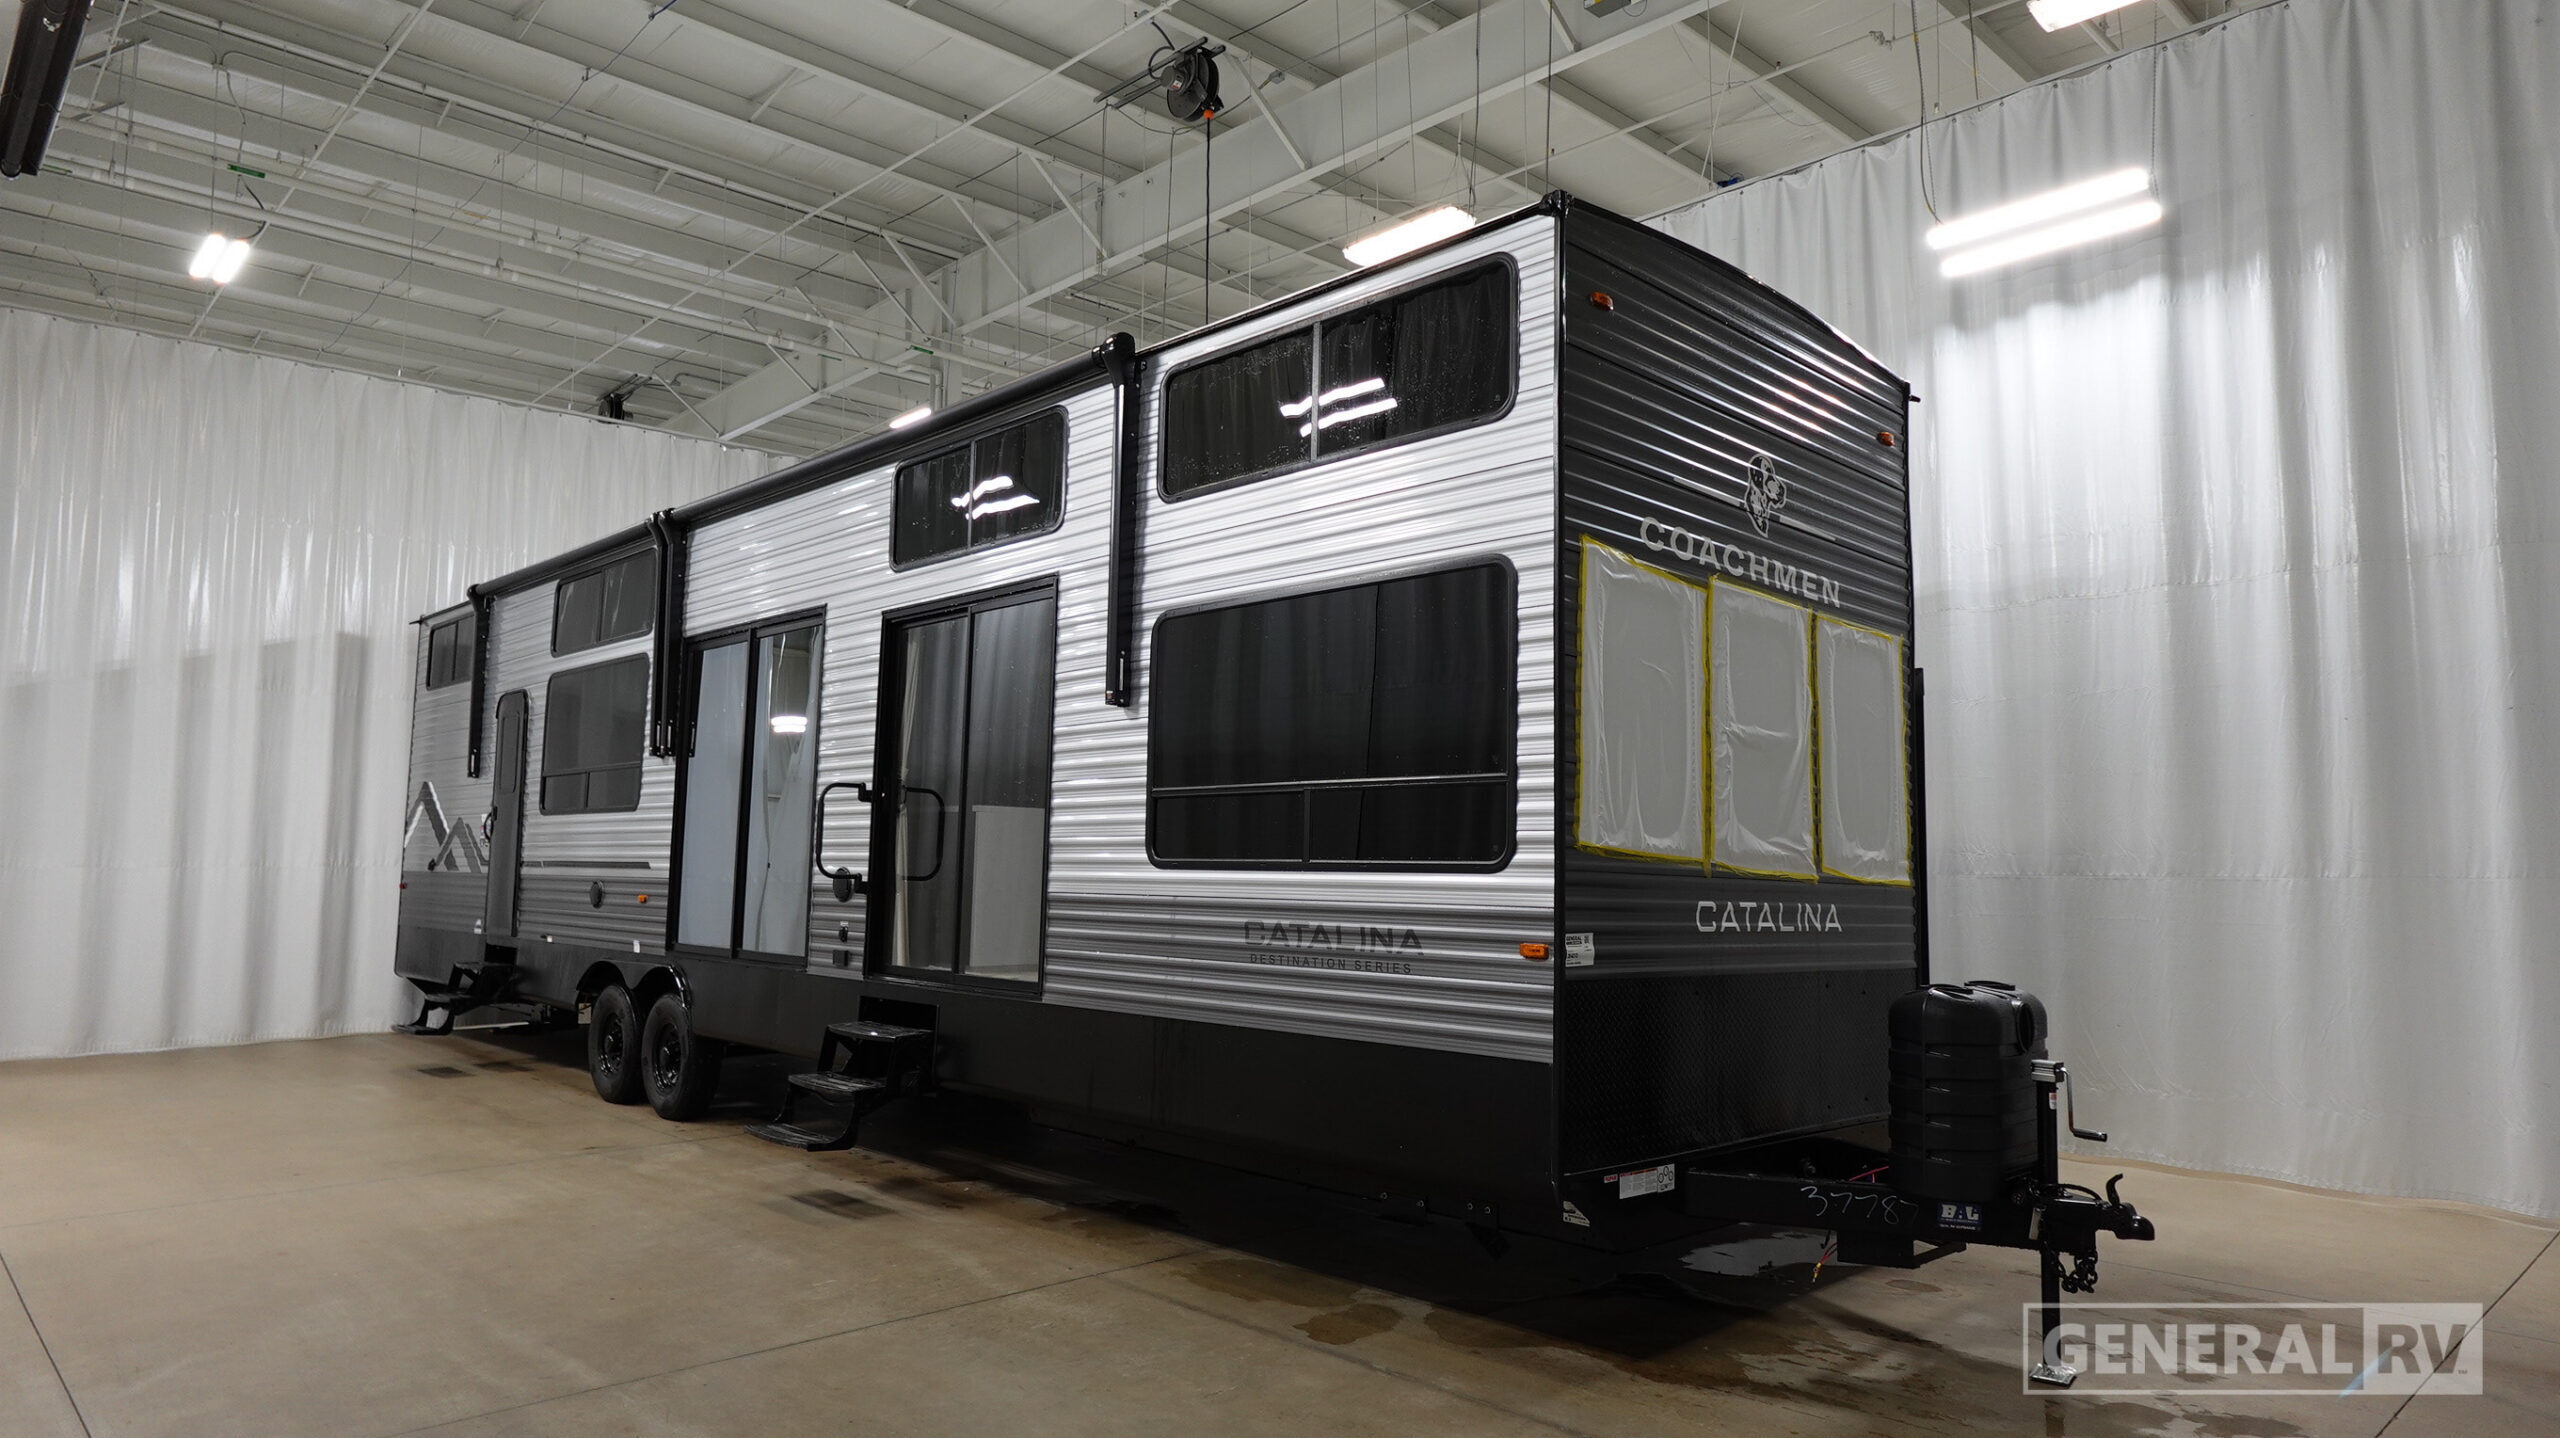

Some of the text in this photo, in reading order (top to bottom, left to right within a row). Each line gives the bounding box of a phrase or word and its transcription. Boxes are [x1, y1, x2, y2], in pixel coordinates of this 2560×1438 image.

[1640, 516, 1841, 608] COACHMEN
[1695, 900, 1843, 933] CATALINA
[1243, 919, 1425, 956] CATALINA
[1249, 953, 1412, 974] DESTINATION SERIES
